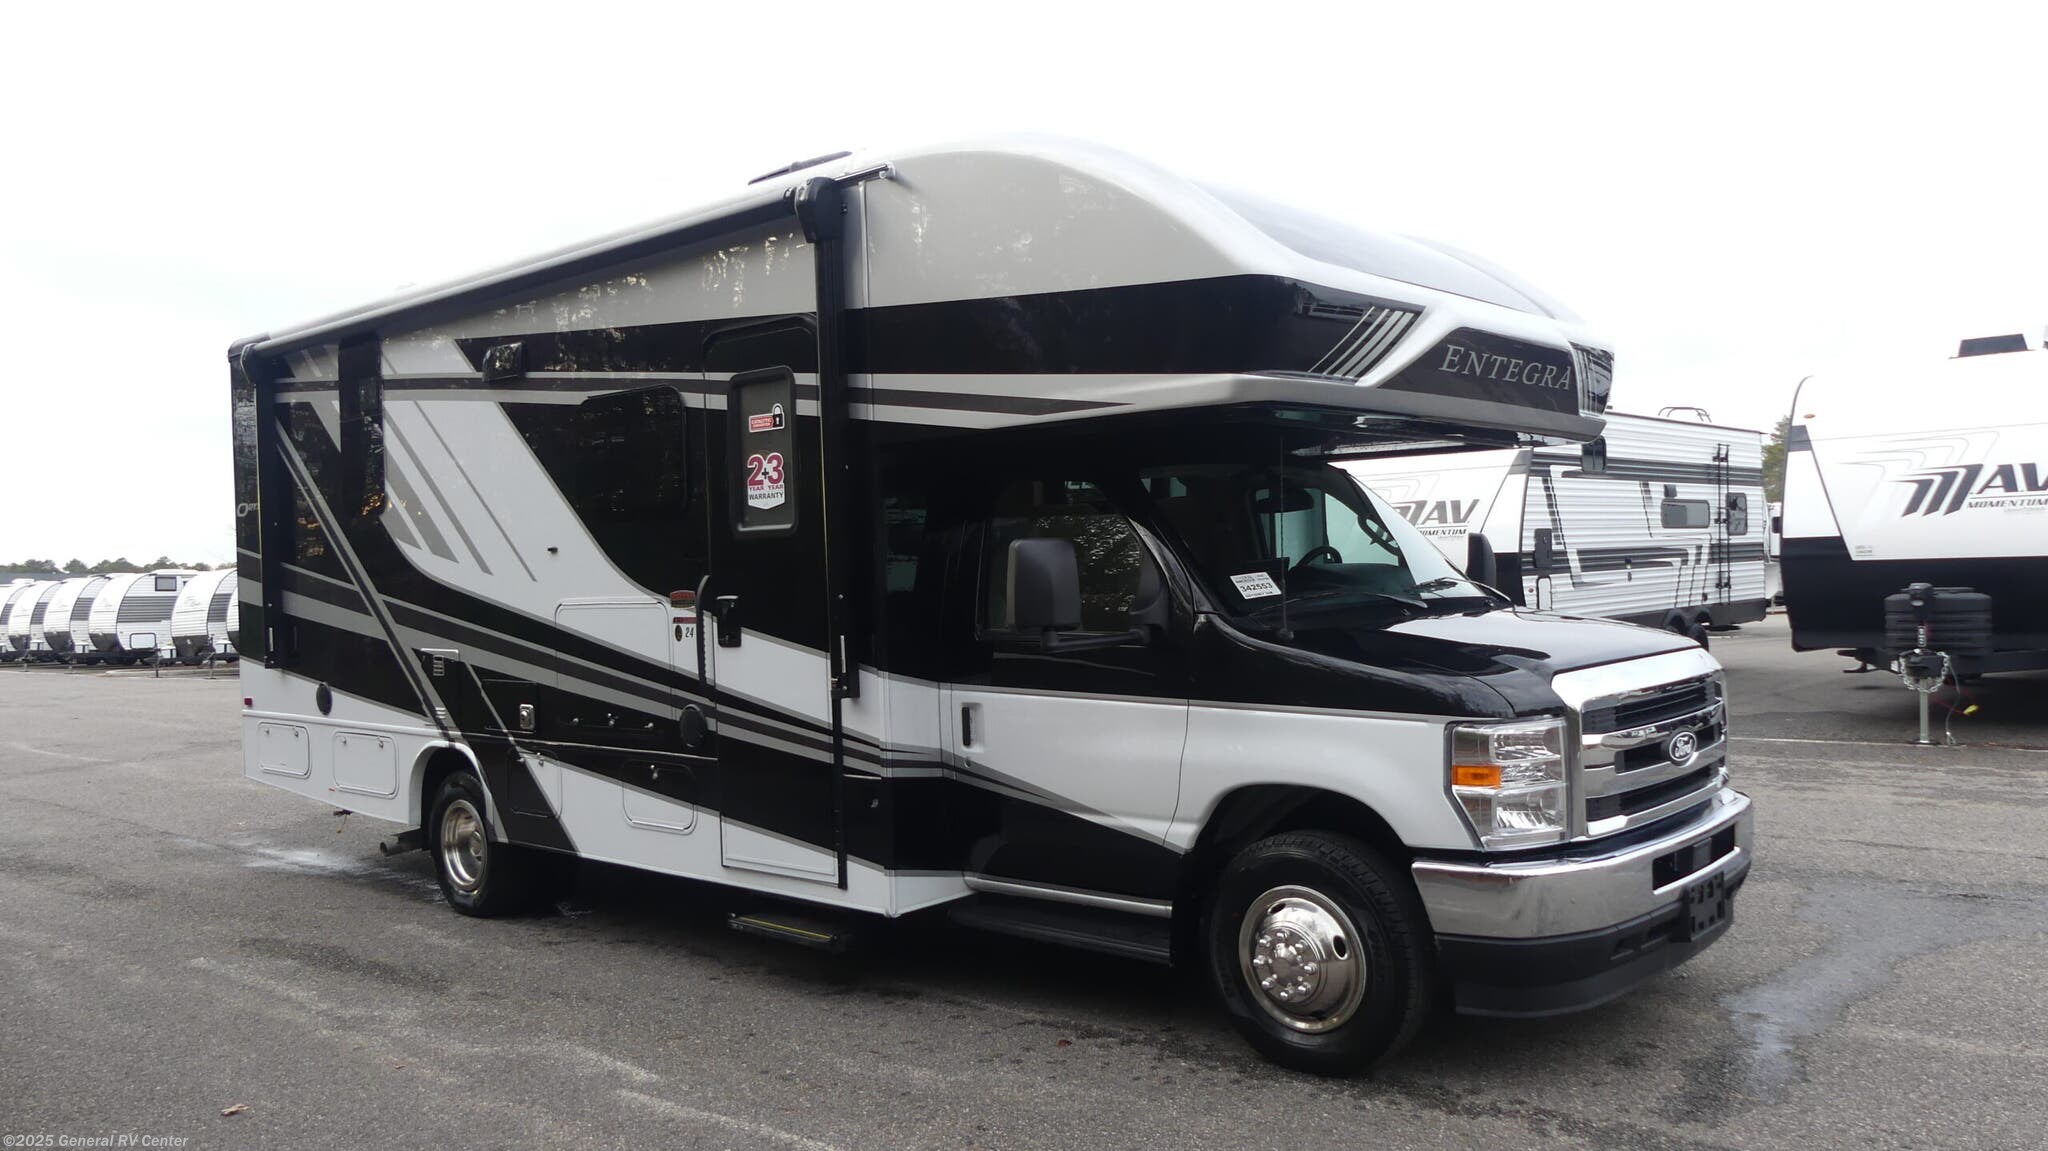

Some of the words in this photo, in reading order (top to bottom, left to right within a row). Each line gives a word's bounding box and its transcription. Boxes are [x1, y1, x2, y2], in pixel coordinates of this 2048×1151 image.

[1438, 344, 1572, 390] ENTEGRA
[749, 492, 784, 500] WARRANTY
[1967, 498, 2048, 509] MOMENTUM
[1240, 582, 1273, 593] 342553
